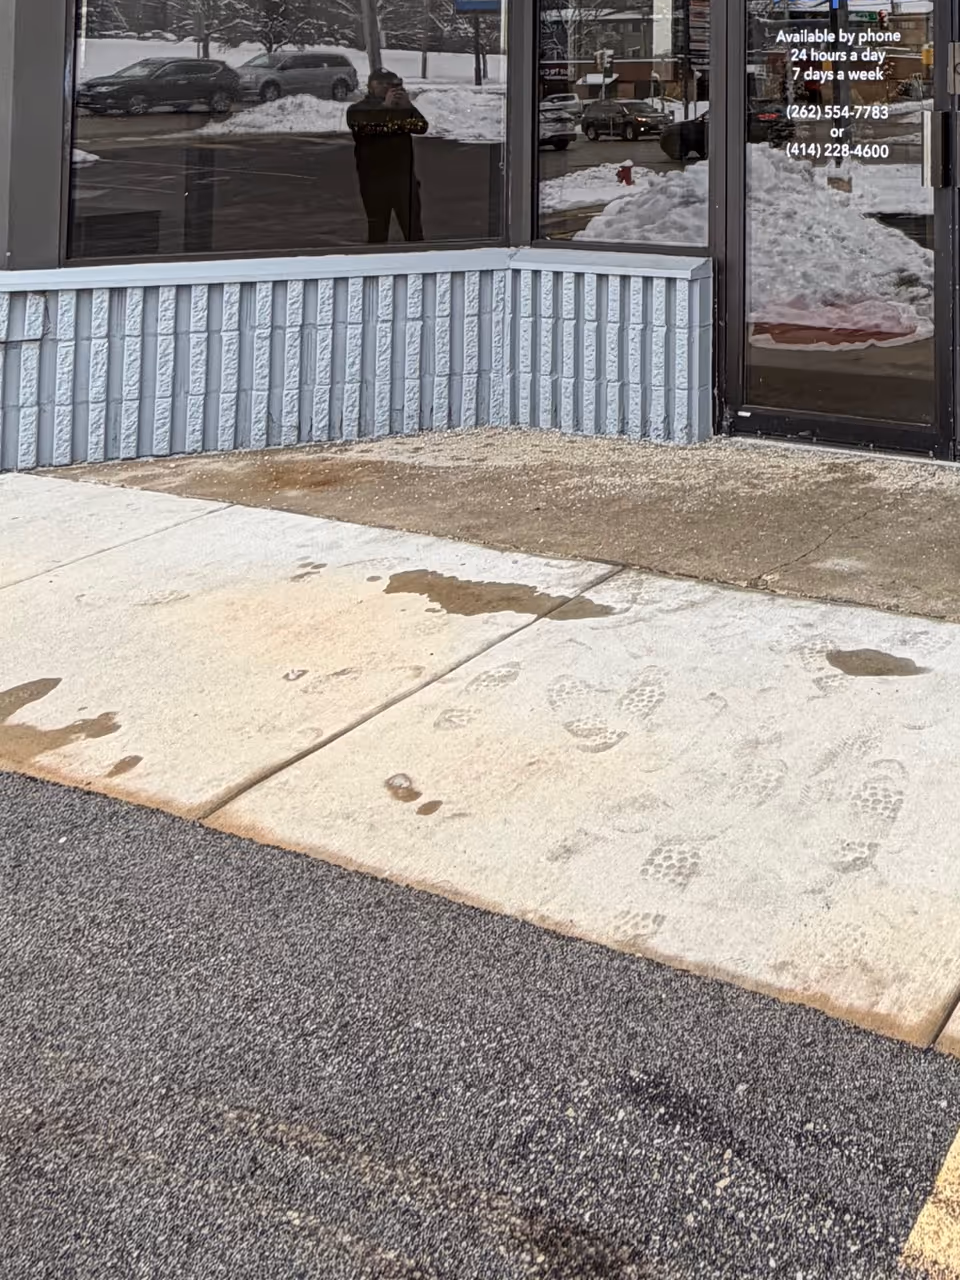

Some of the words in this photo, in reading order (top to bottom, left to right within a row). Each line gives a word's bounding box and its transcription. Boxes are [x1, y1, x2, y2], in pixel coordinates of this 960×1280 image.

[776, 29, 836, 43] Available
[839, 28, 856, 46] by
[858, 28, 901, 45] phone
[790, 48, 808, 61] 24
[810, 48, 847, 61] hours
[849, 51, 858, 61] a
[861, 48, 886, 64] day
[792, 67, 801, 81] 7
[804, 67, 834, 84] days
[836, 70, 845, 80] a
[848, 66, 884, 81] week
[786, 105, 821, 120] (262)
[824, 105, 889, 119] 554-7783
[830, 127, 845, 138] or
[786, 142, 821, 158] (414)
[824, 144, 889, 158] 228-4600
